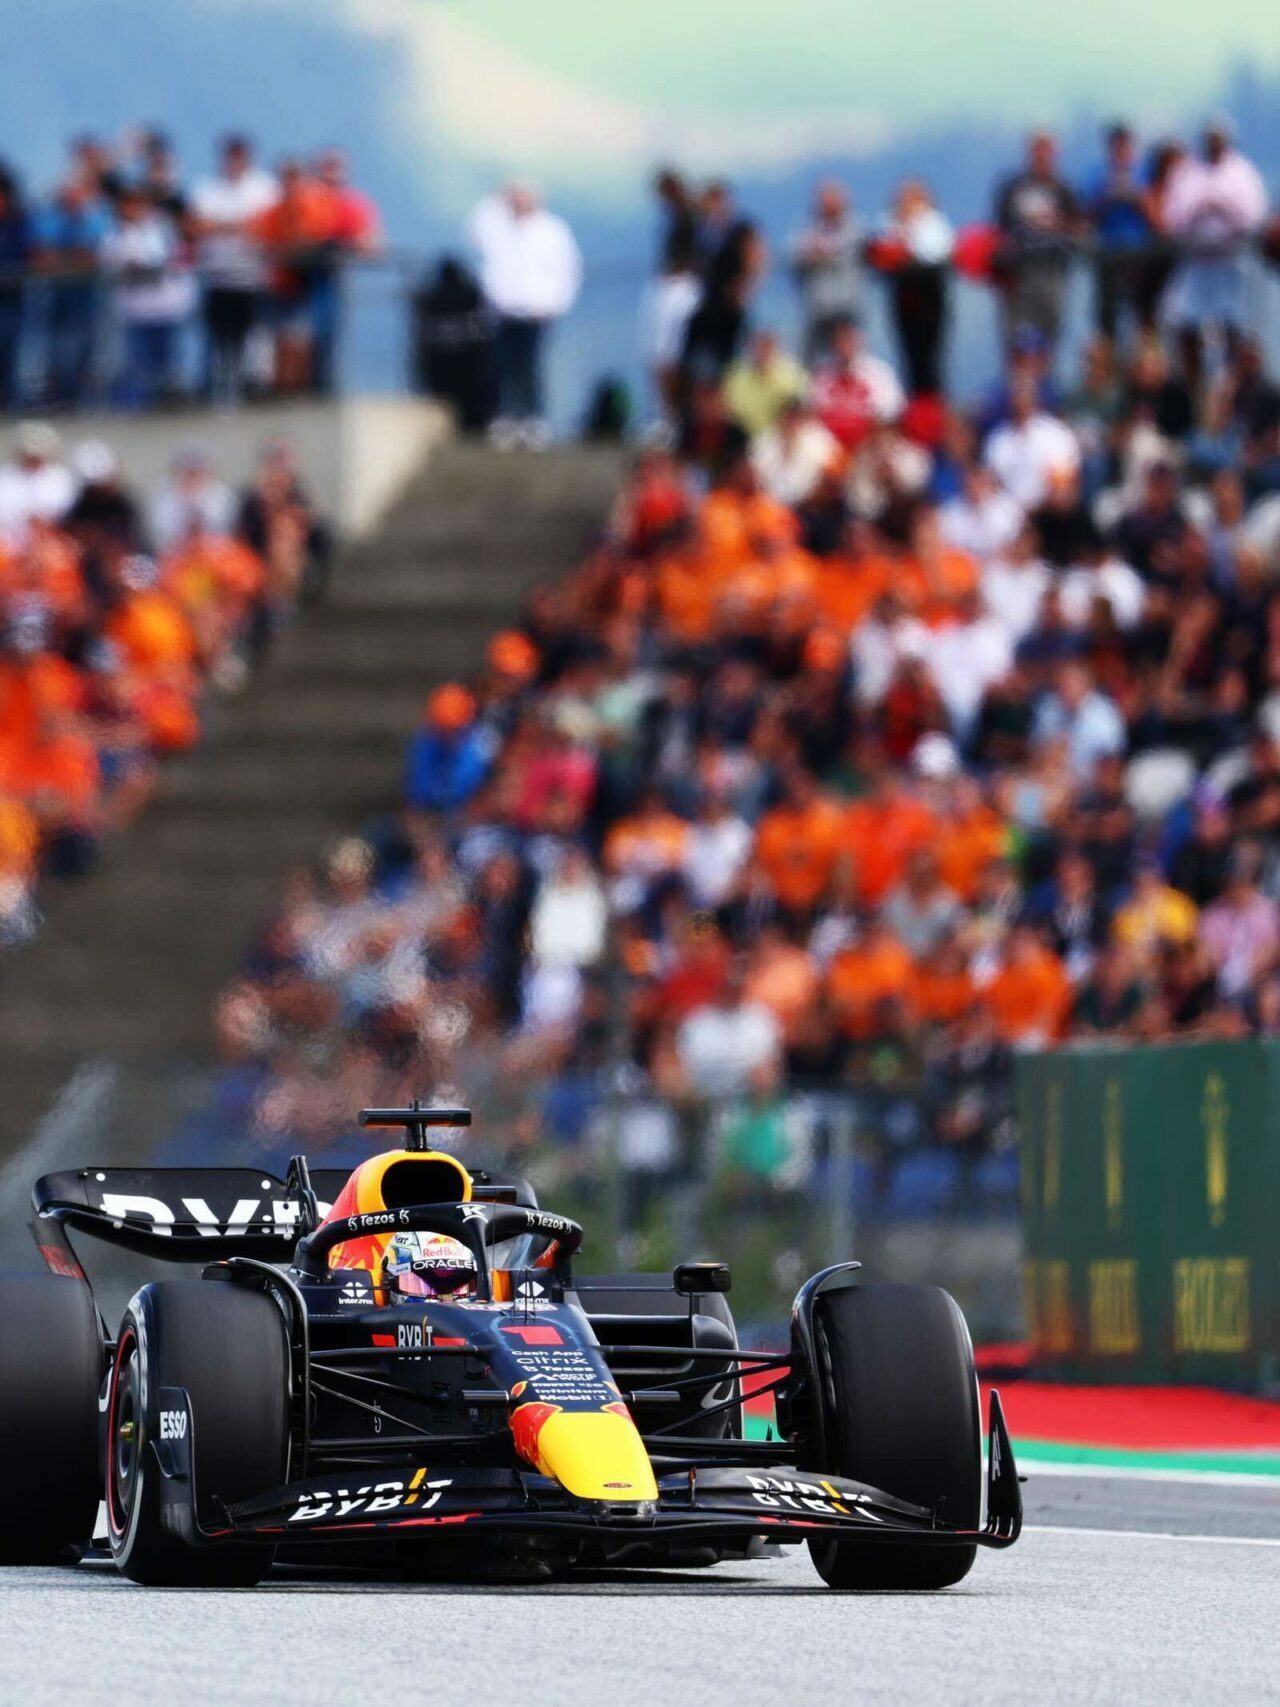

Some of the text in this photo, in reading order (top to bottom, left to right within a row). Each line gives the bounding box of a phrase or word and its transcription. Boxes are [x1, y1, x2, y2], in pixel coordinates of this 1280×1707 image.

[360, 1213, 395, 1227] Tezos
[535, 1212, 564, 1230] Tezos
[423, 1247, 442, 1257] Red
[413, 1259, 473, 1270] ORACLE
[498, 1326, 565, 1345] 1
[160, 1410, 186, 1439] ESSO
[288, 1467, 453, 1522] BYBIT
